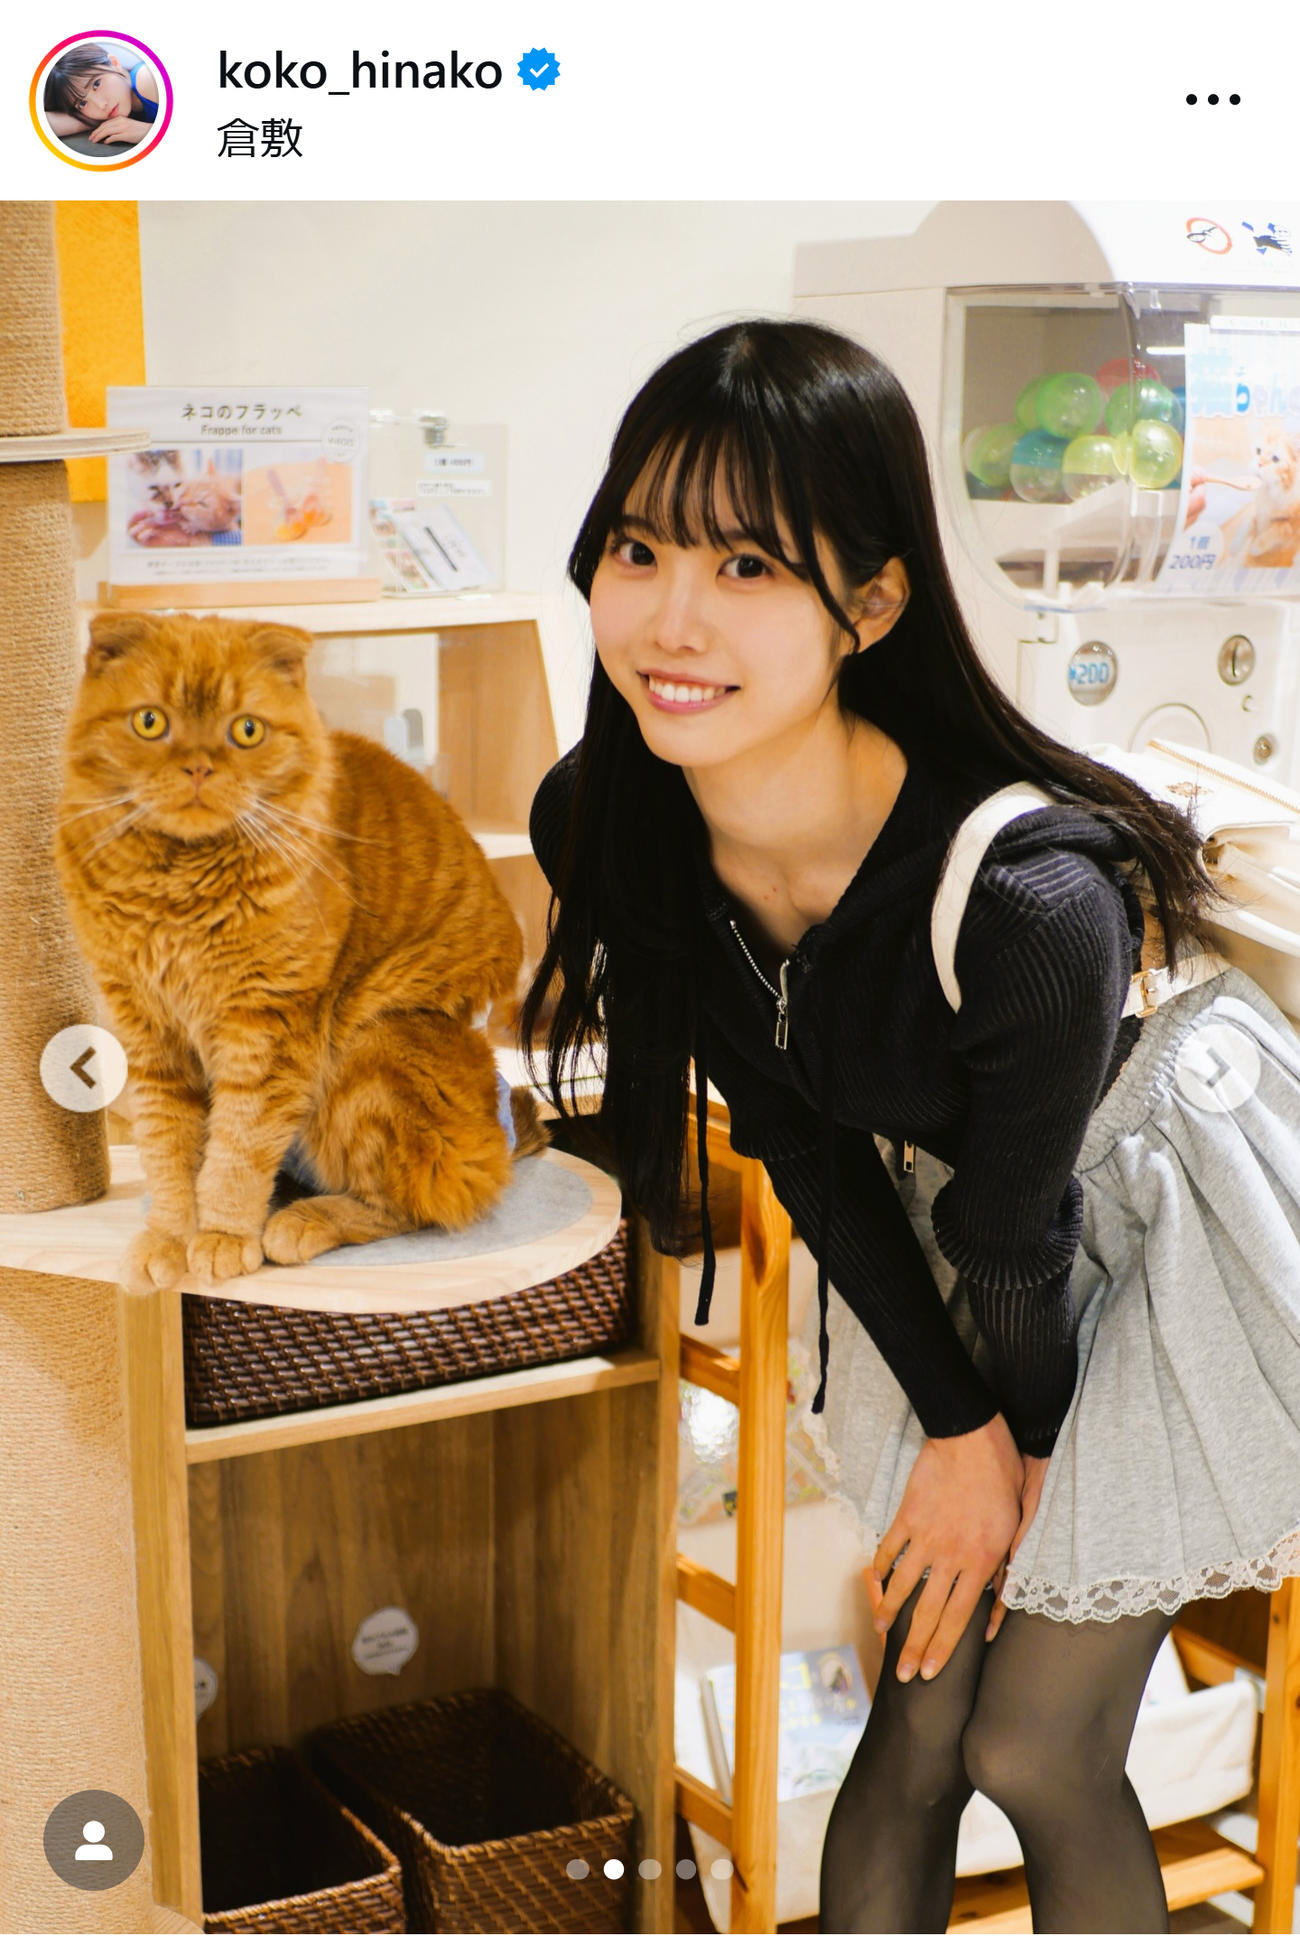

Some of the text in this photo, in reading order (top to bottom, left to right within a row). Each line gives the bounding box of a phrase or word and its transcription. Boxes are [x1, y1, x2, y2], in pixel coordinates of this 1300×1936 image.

[200, 424, 283, 436] Frappe for cats
[1168, 554, 1217, 570] 200円
